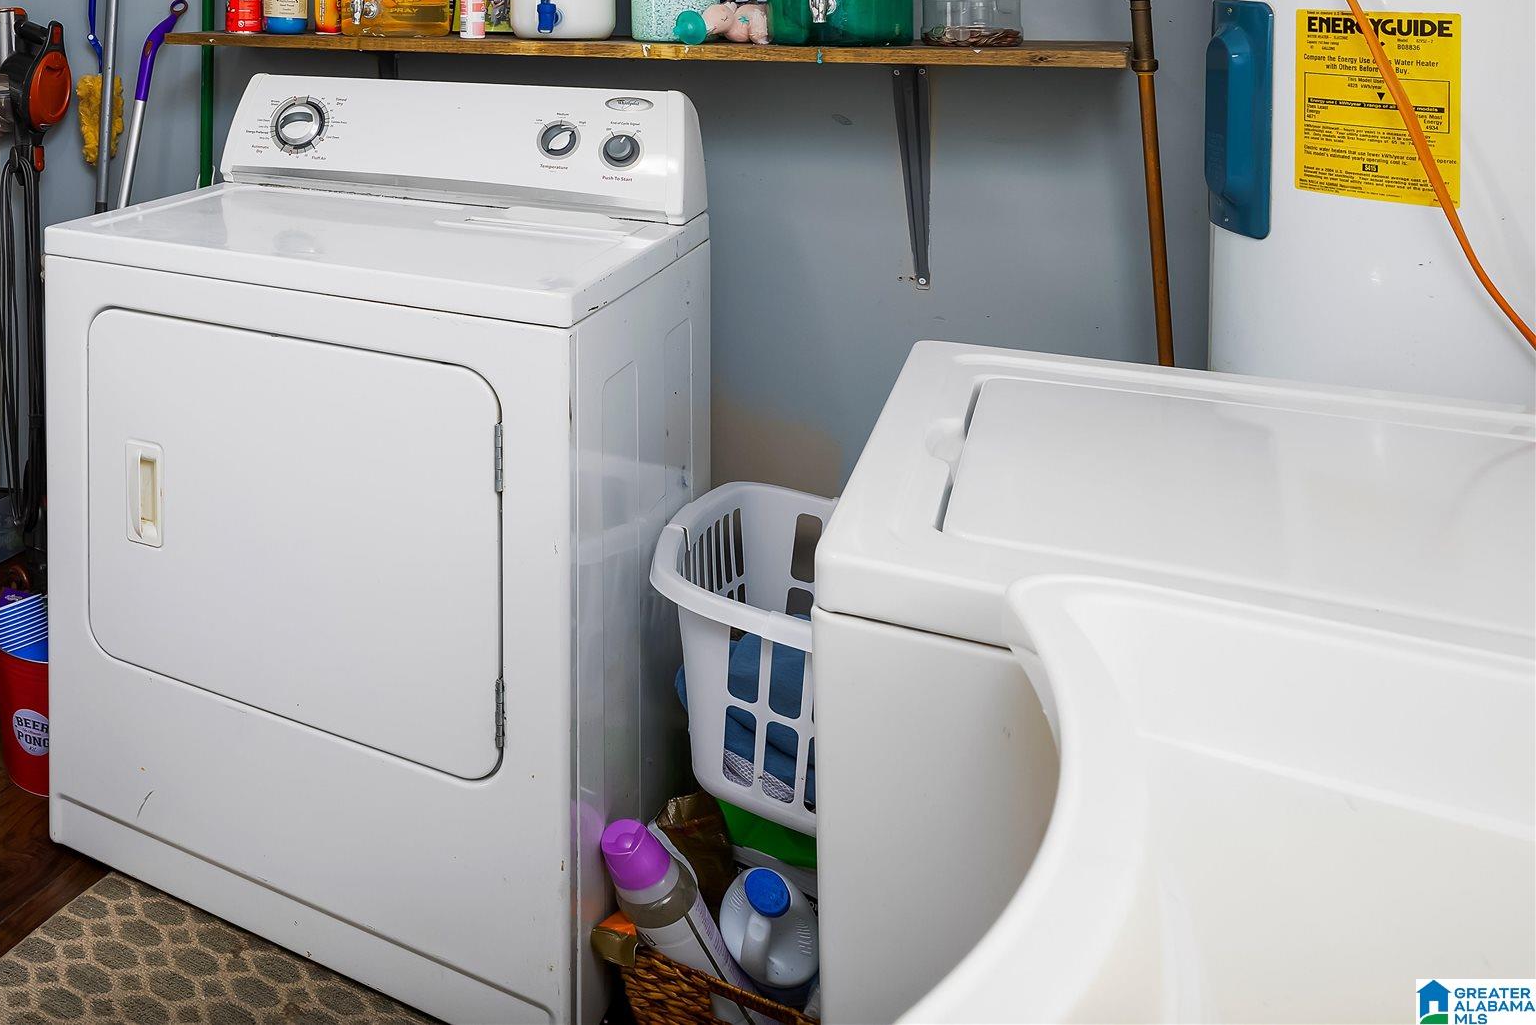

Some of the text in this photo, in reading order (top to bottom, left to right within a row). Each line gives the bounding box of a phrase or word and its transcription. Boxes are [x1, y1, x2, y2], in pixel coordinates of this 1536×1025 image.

[1307, 16, 1453, 38] ENERYGUIDE
[1327, 54, 1337, 62] the
[1337, 56, 1357, 64] Energy
[1394, 58, 1413, 66] Water
[1359, 65, 1379, 73] Before
[1395, 67, 1410, 75] Buy.
[15, 715, 49, 733] BEER
[17, 729, 50, 748] PONG
